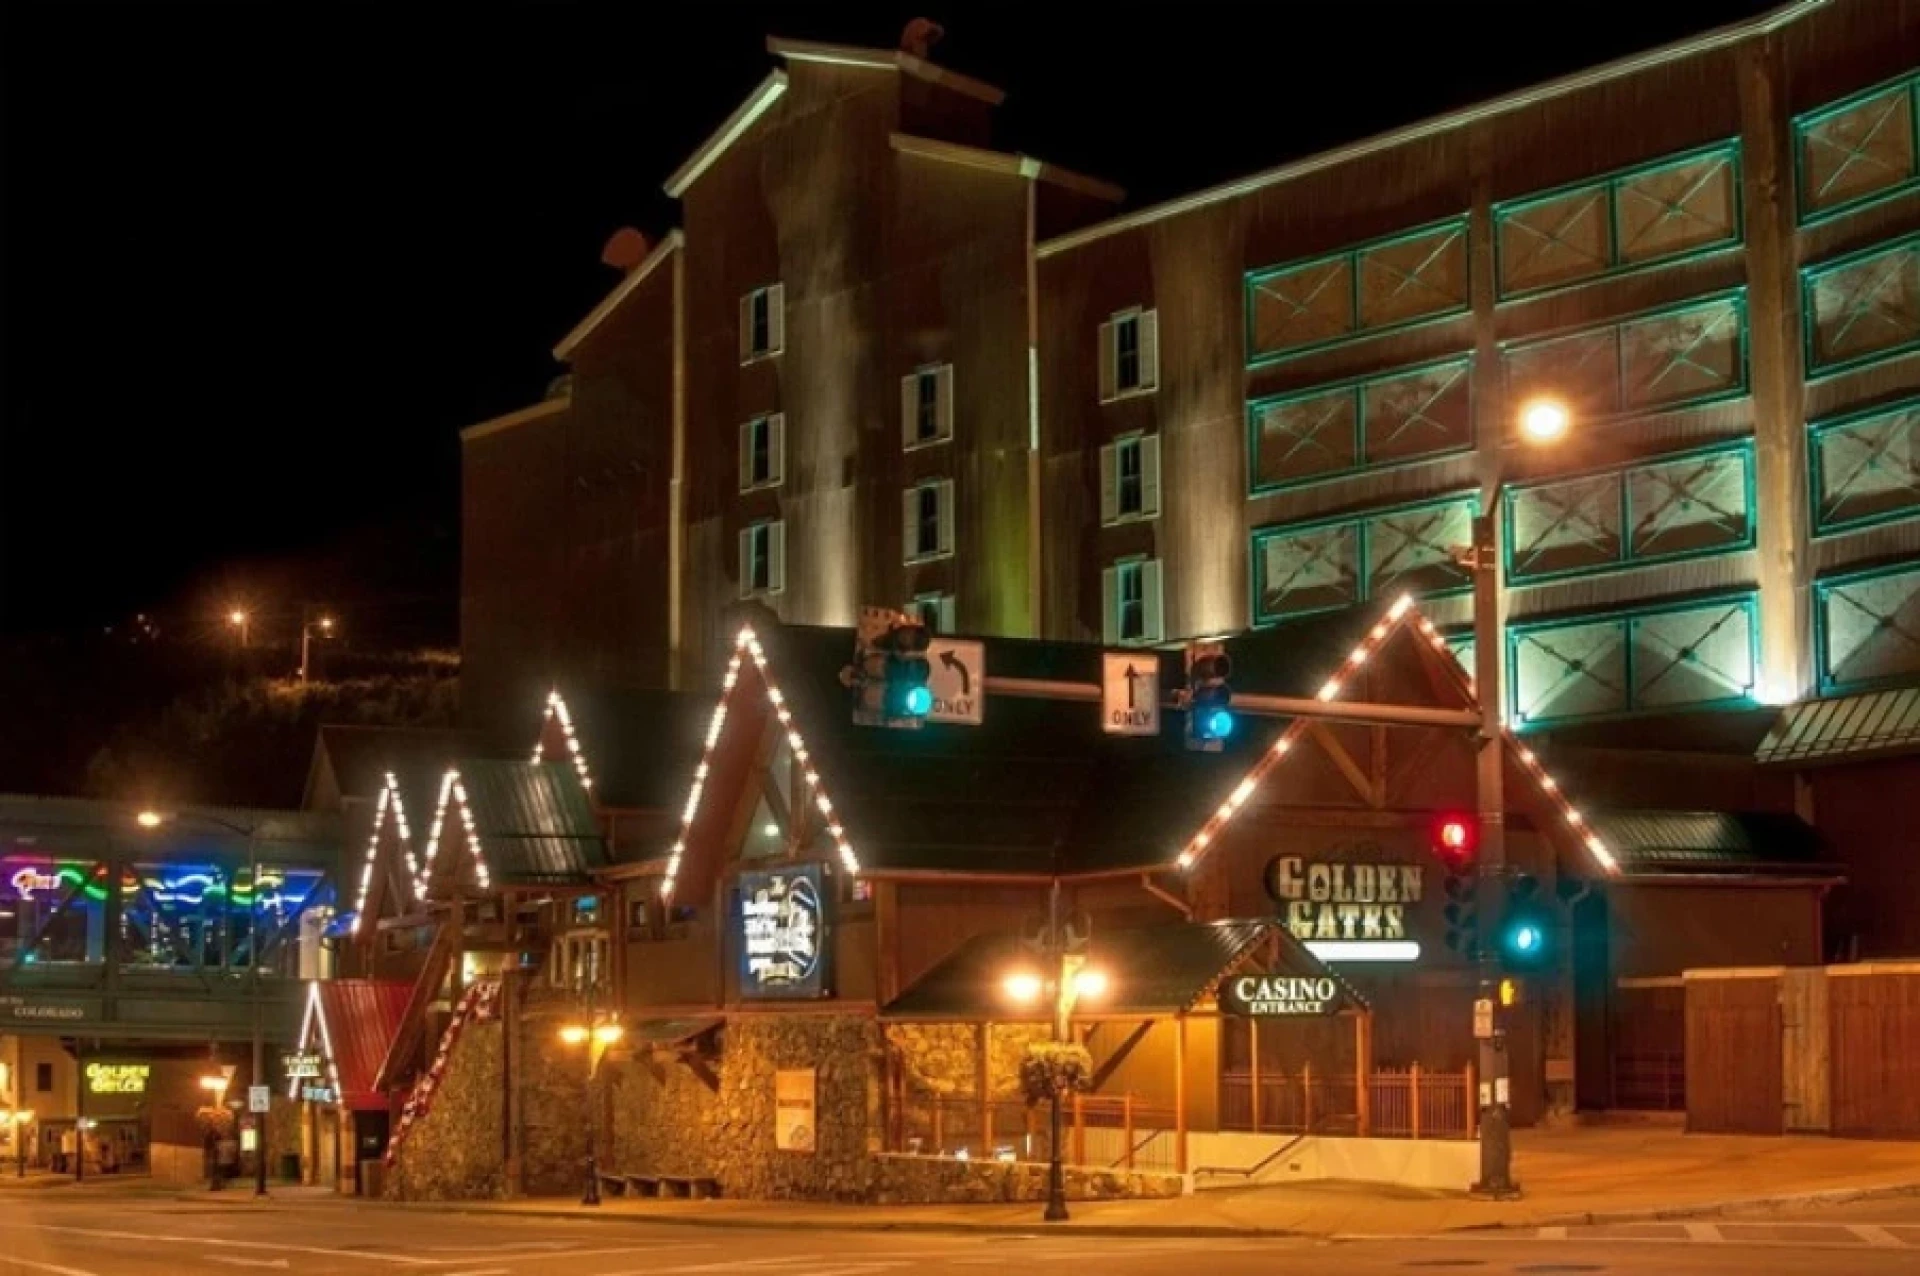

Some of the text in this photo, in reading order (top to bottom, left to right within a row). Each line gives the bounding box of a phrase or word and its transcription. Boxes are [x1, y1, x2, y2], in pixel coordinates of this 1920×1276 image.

[933, 699, 974, 716] ONLY
[1111, 709, 1151, 726] ONLY
[1279, 857, 1423, 901] GOLDEN
[1288, 901, 1405, 938] GATES
[1236, 977, 1336, 1001] CASINO
[1251, 1001, 1322, 1014] ENTRANCE
